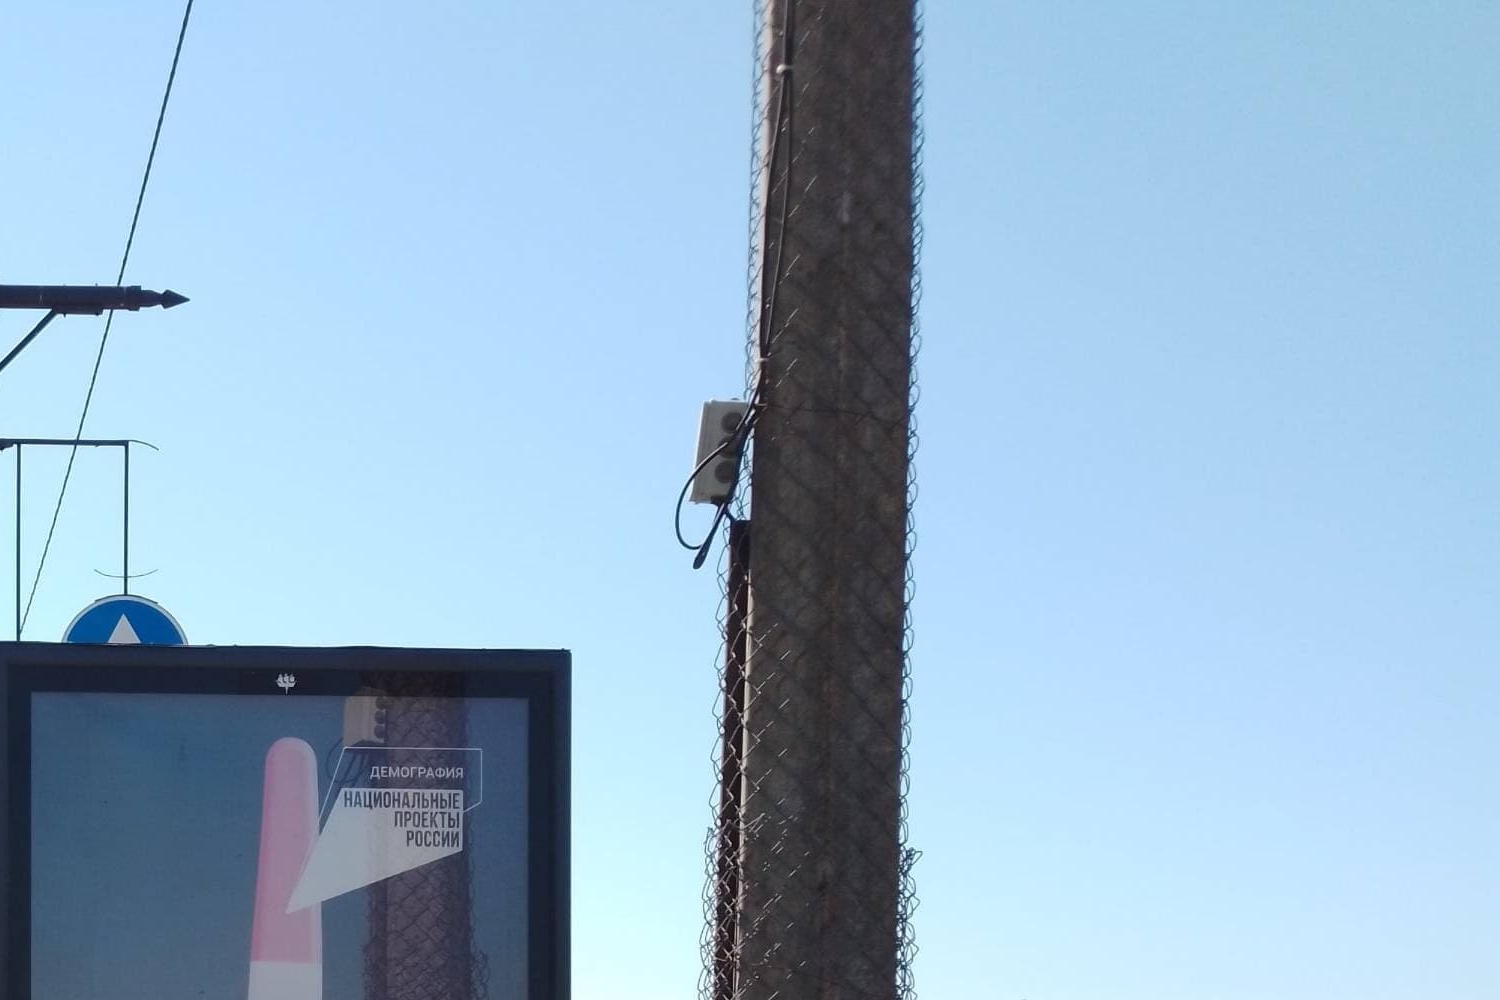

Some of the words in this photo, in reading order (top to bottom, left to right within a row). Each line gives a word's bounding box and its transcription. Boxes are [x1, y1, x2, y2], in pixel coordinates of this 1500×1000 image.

[370, 766, 464, 779] ДЕМОГРАФИЯ
[343, 790, 460, 809] НАЦИОНАЛЬНЫЕ
[394, 811, 460, 828] ПРОЕКТЫ
[406, 830, 460, 848] РОССИИ
